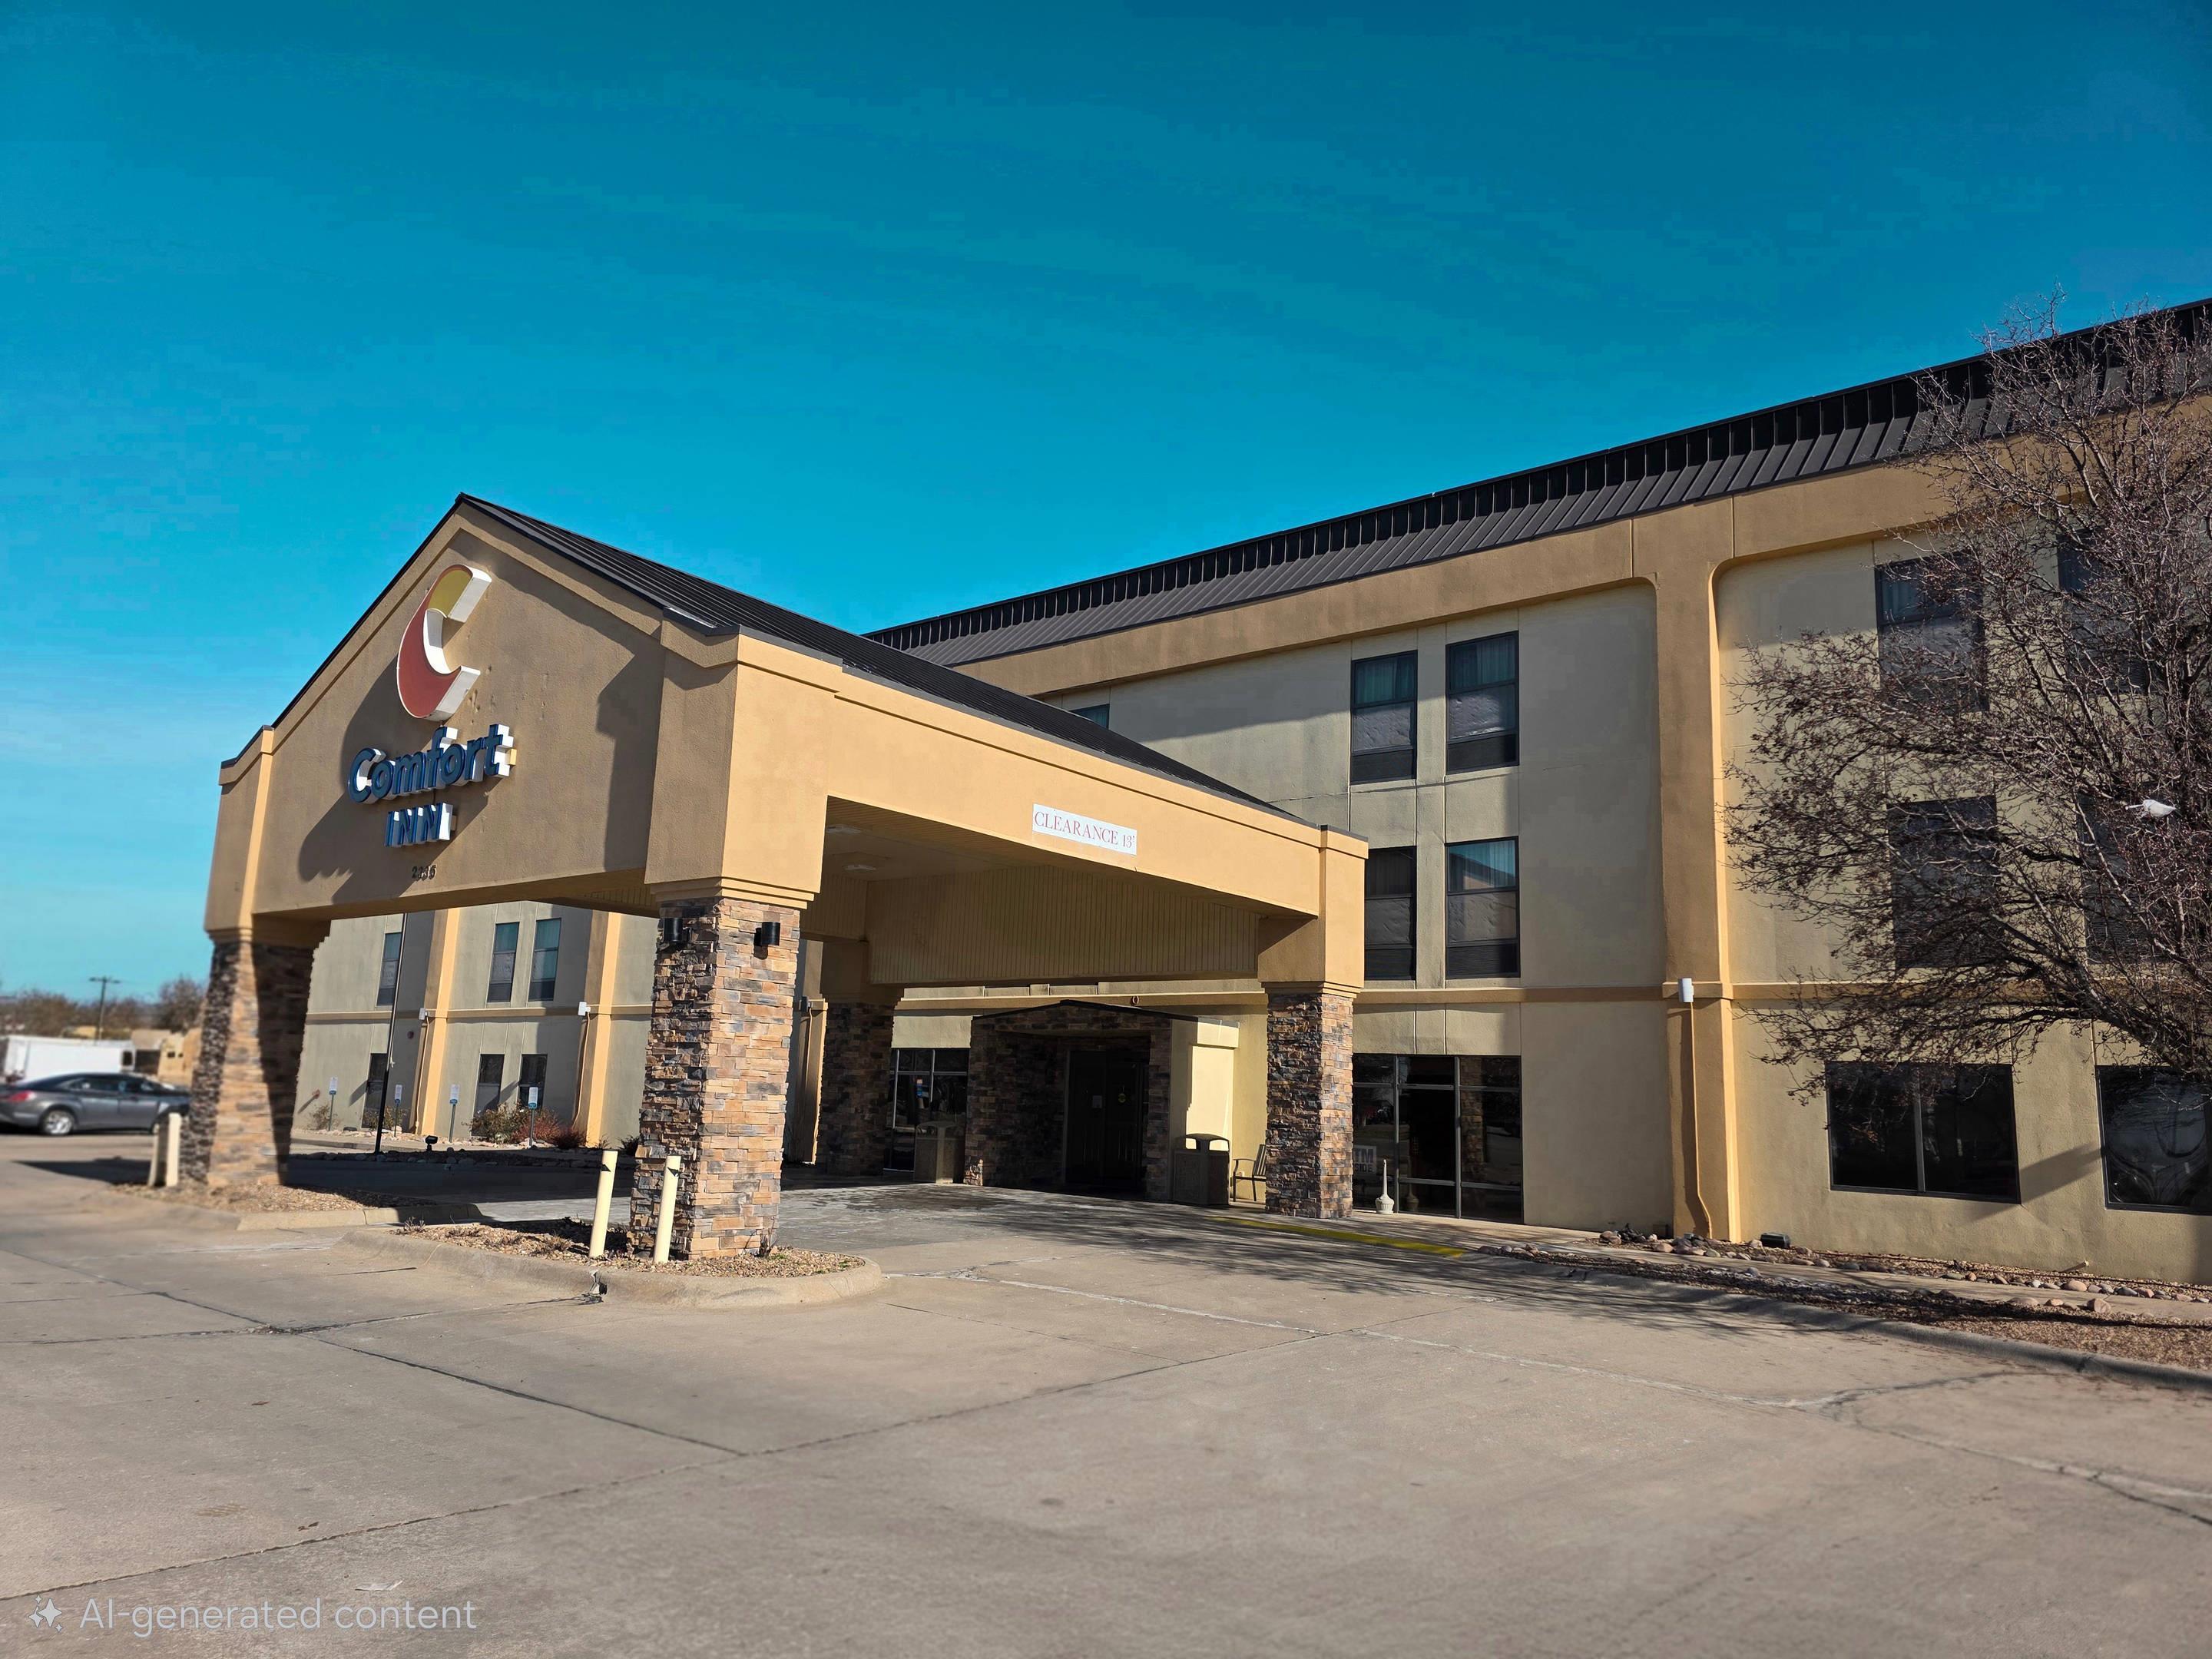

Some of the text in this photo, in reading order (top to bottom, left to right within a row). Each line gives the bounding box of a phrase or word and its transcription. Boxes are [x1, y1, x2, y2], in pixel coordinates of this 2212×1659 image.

[349, 724, 512, 803] Comfort
[386, 803, 451, 846] INN
[1035, 811, 1135, 849] CLEARANCE 13'
[1353, 1148, 1374, 1163] TM
[1353, 1163, 1373, 1173] SIDE
